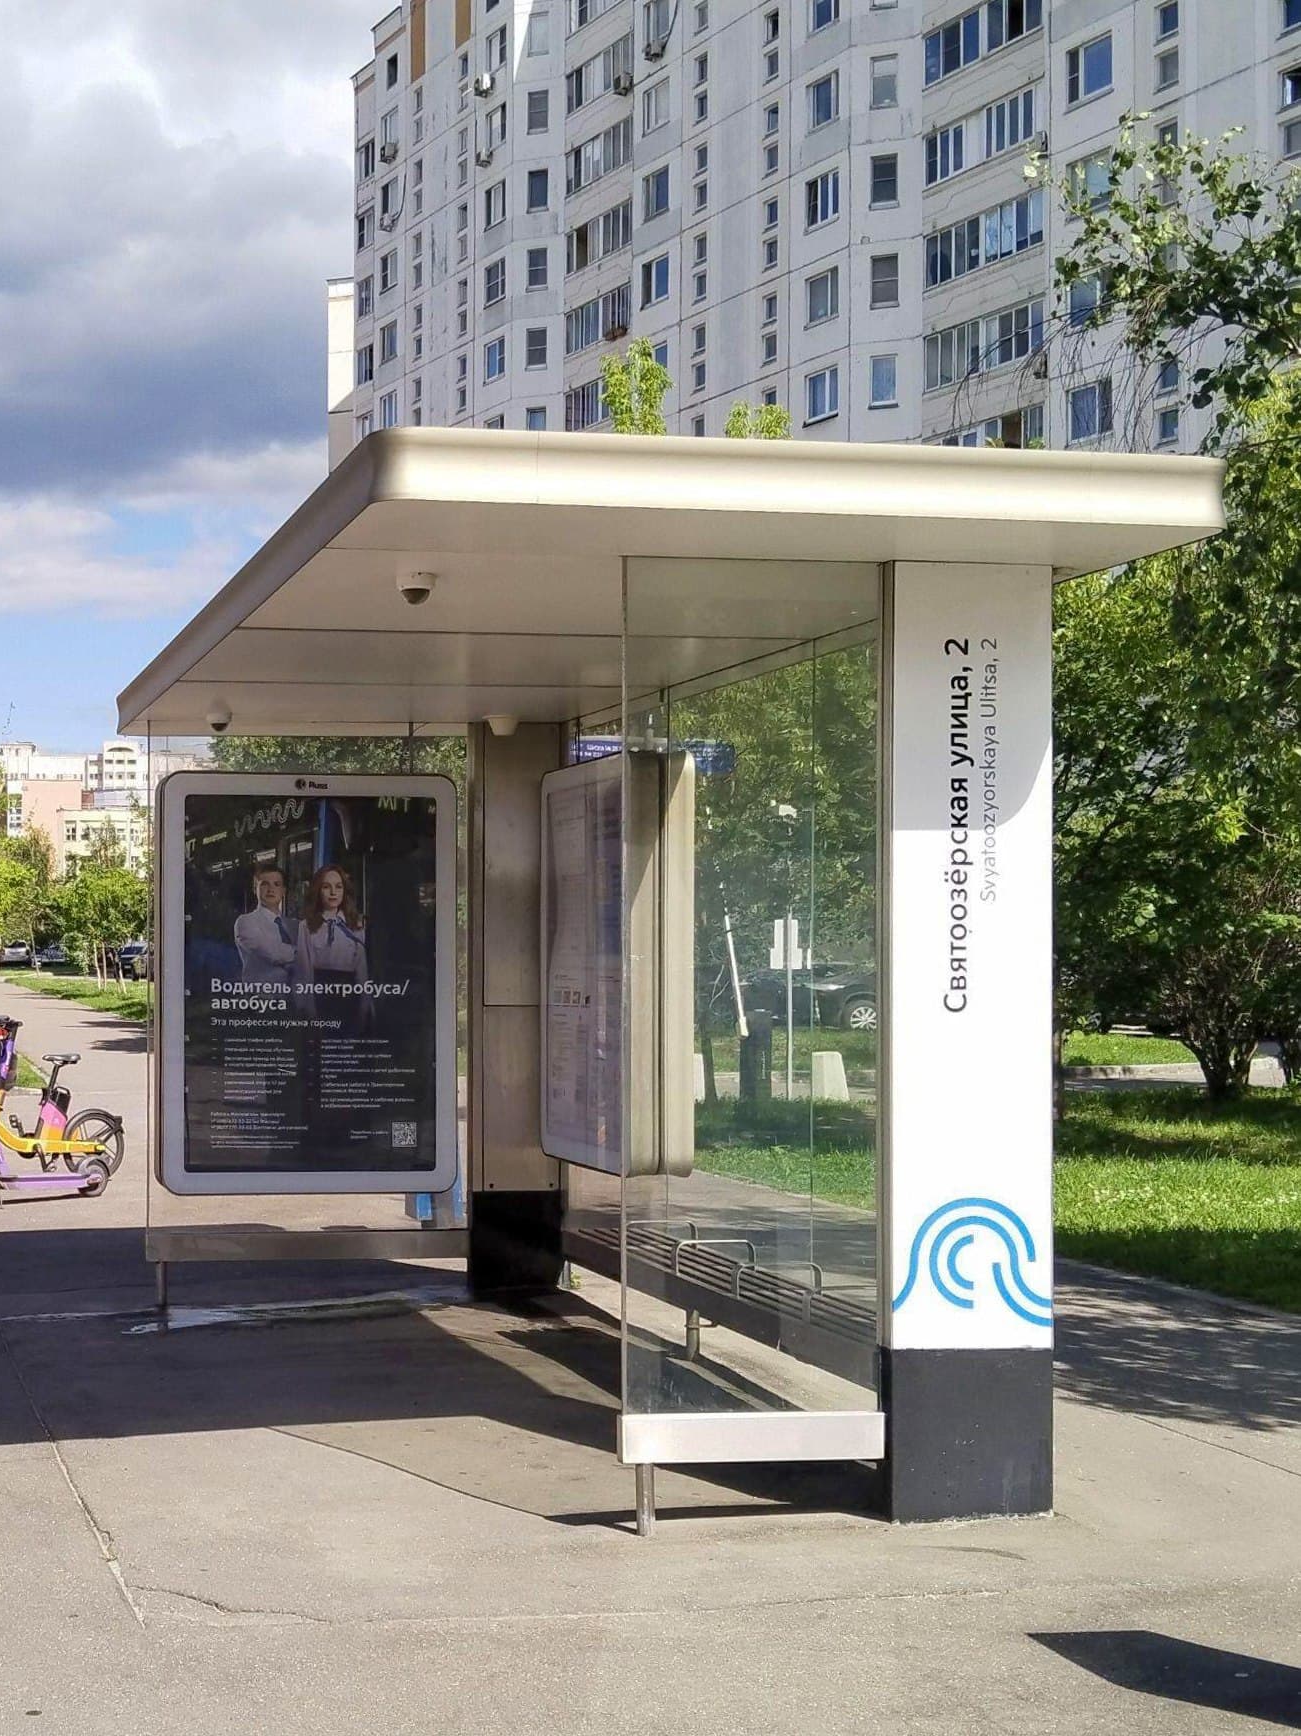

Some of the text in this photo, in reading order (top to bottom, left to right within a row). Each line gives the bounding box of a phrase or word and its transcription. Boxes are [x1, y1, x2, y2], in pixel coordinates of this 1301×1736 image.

[980, 638, 999, 903] Svyatoozyorskaya Ulitsa, 2
[943, 637, 974, 1014] Святоозёрская улица, 2
[210, 978, 410, 998] Водитель электробуса/
[211, 995, 287, 1013] автобуса
[210, 1017, 342, 1029] Эта профессия нужна городу
